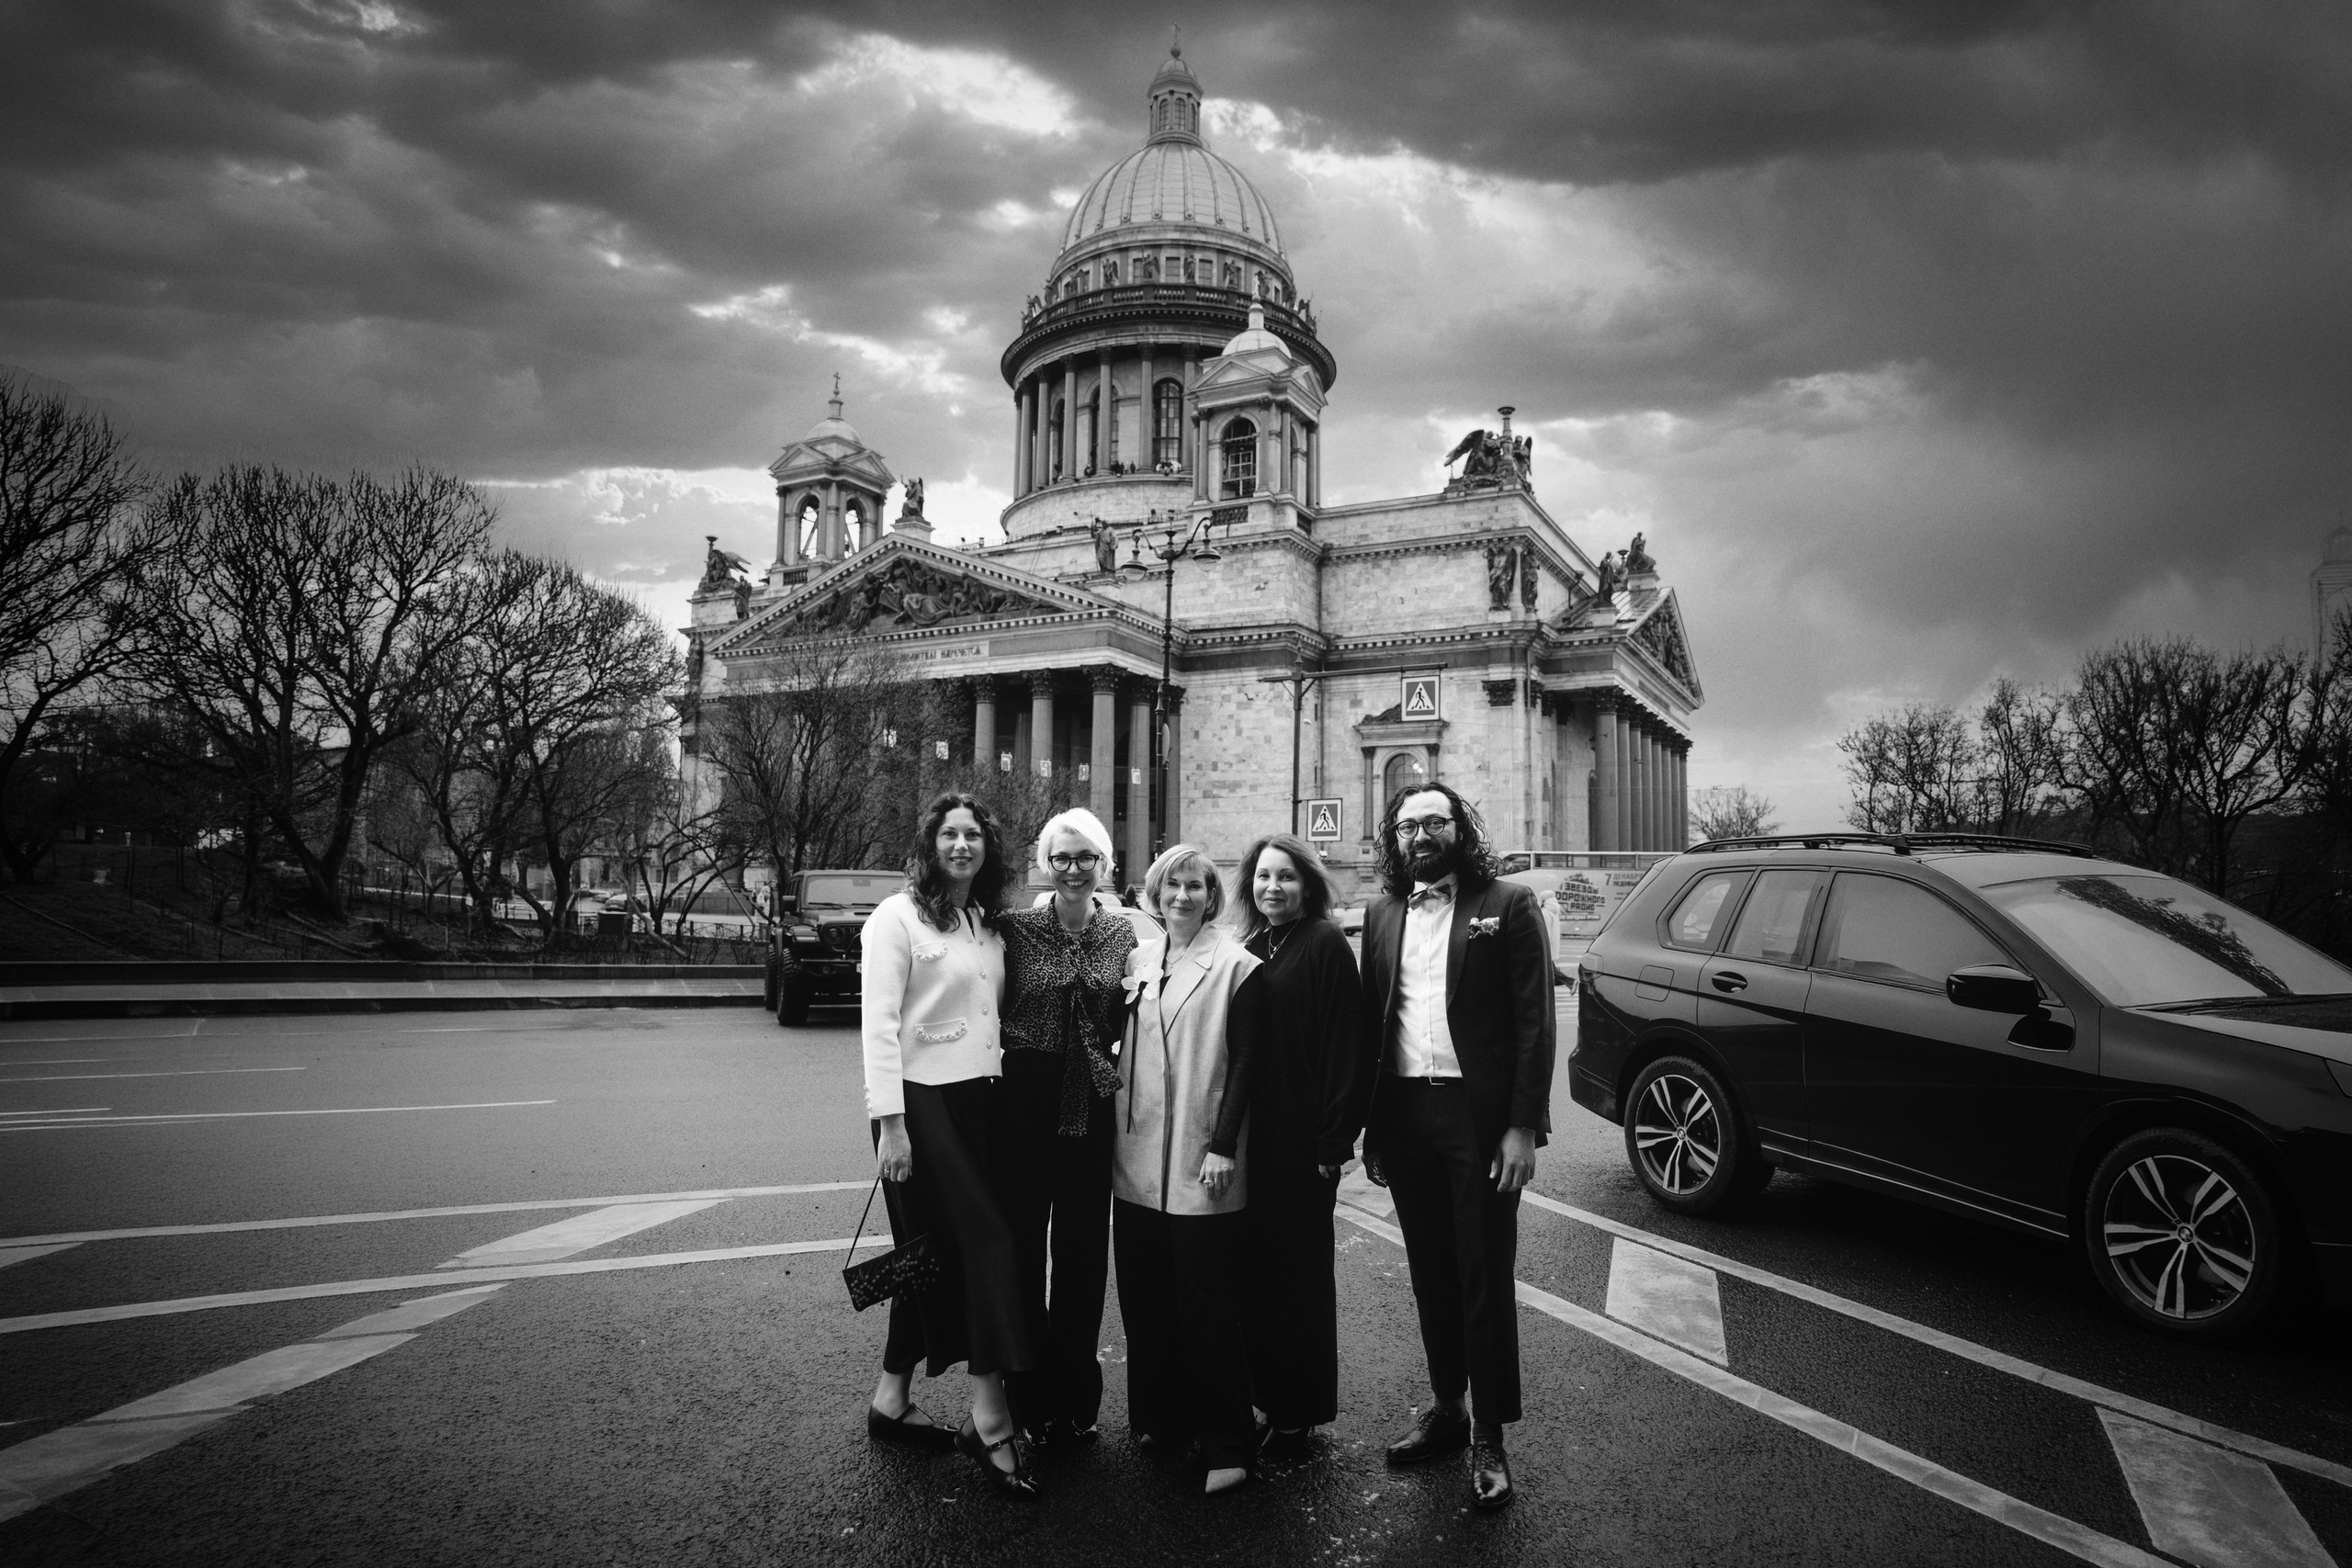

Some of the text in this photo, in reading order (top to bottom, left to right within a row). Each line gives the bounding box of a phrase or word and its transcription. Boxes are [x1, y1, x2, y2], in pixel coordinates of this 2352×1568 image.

[1605, 874, 1611, 886] 7
[1565, 882, 1599, 894] ЗВЕЗДЫ
[1555, 891, 1605, 904] ДОРОЖНОГО
